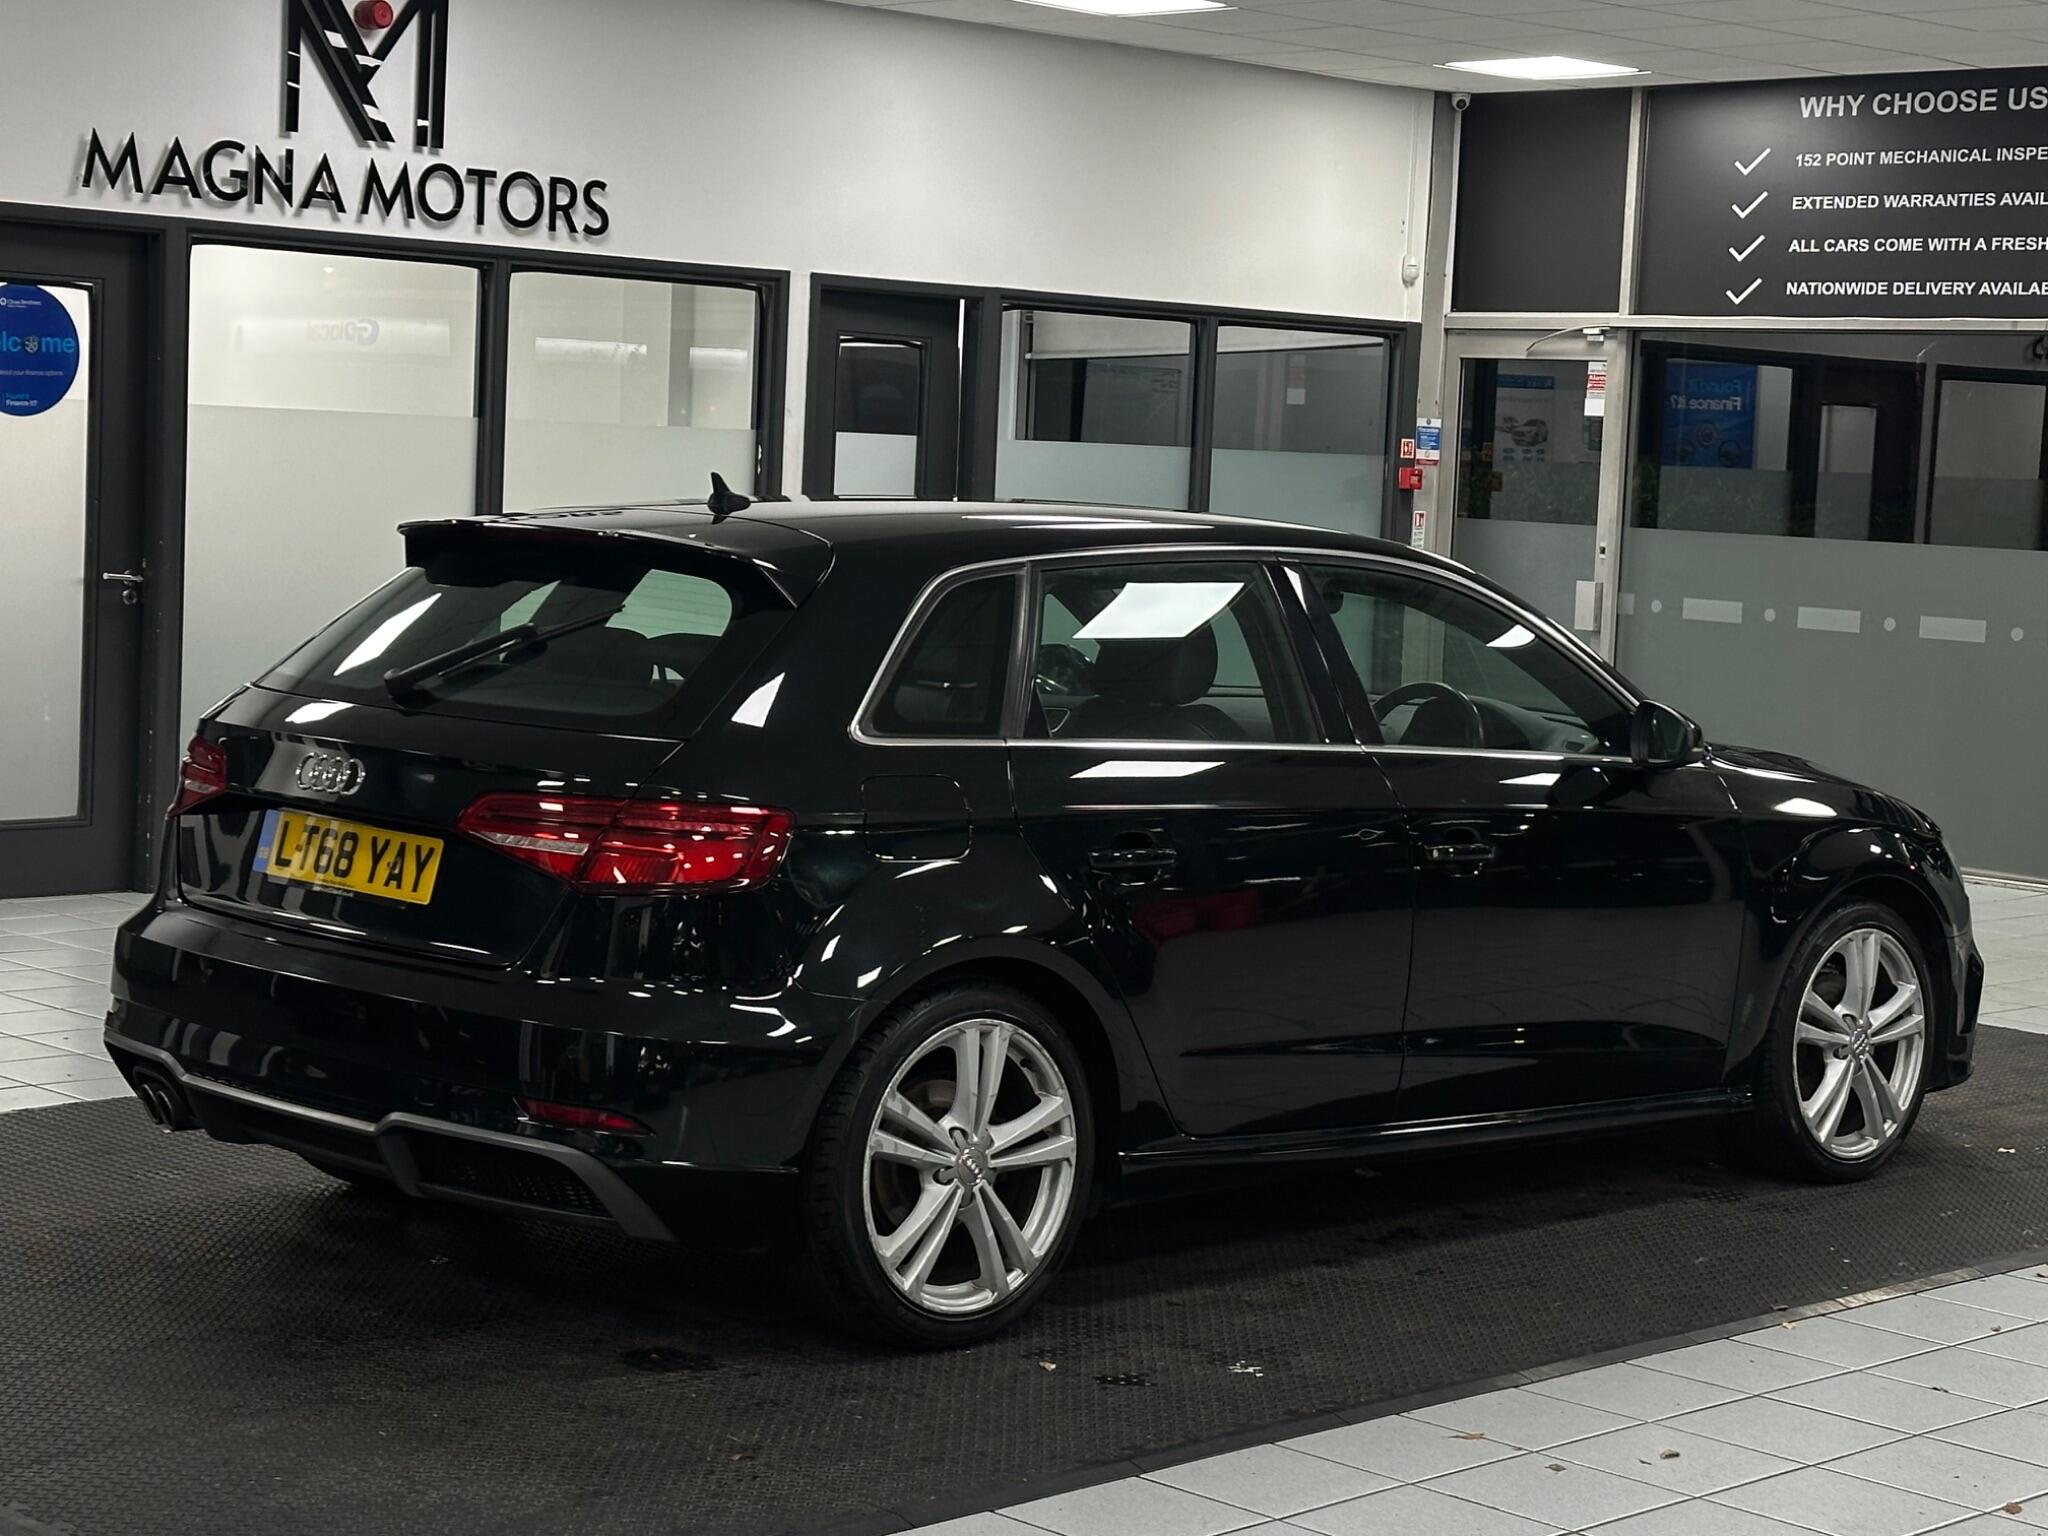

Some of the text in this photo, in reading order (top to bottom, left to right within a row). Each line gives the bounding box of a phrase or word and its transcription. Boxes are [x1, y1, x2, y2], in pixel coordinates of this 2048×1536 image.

[1800, 86, 2048, 118] WHY CHOOSE US
[1795, 146, 2048, 168] 152 POINT MECHANICAL INSPE
[82, 128, 609, 236] MAGNA MOTORS
[1792, 192, 2048, 210] EXTENDED WARRANTIES AVAIL
[1788, 237, 2048, 253] ALL CARS COME WITH A FRESH
[1786, 281, 1888, 296] NATIONWIDE
[1892, 281, 1976, 296] DELIVERY
[275, 821, 435, 893] LT68 YAY
